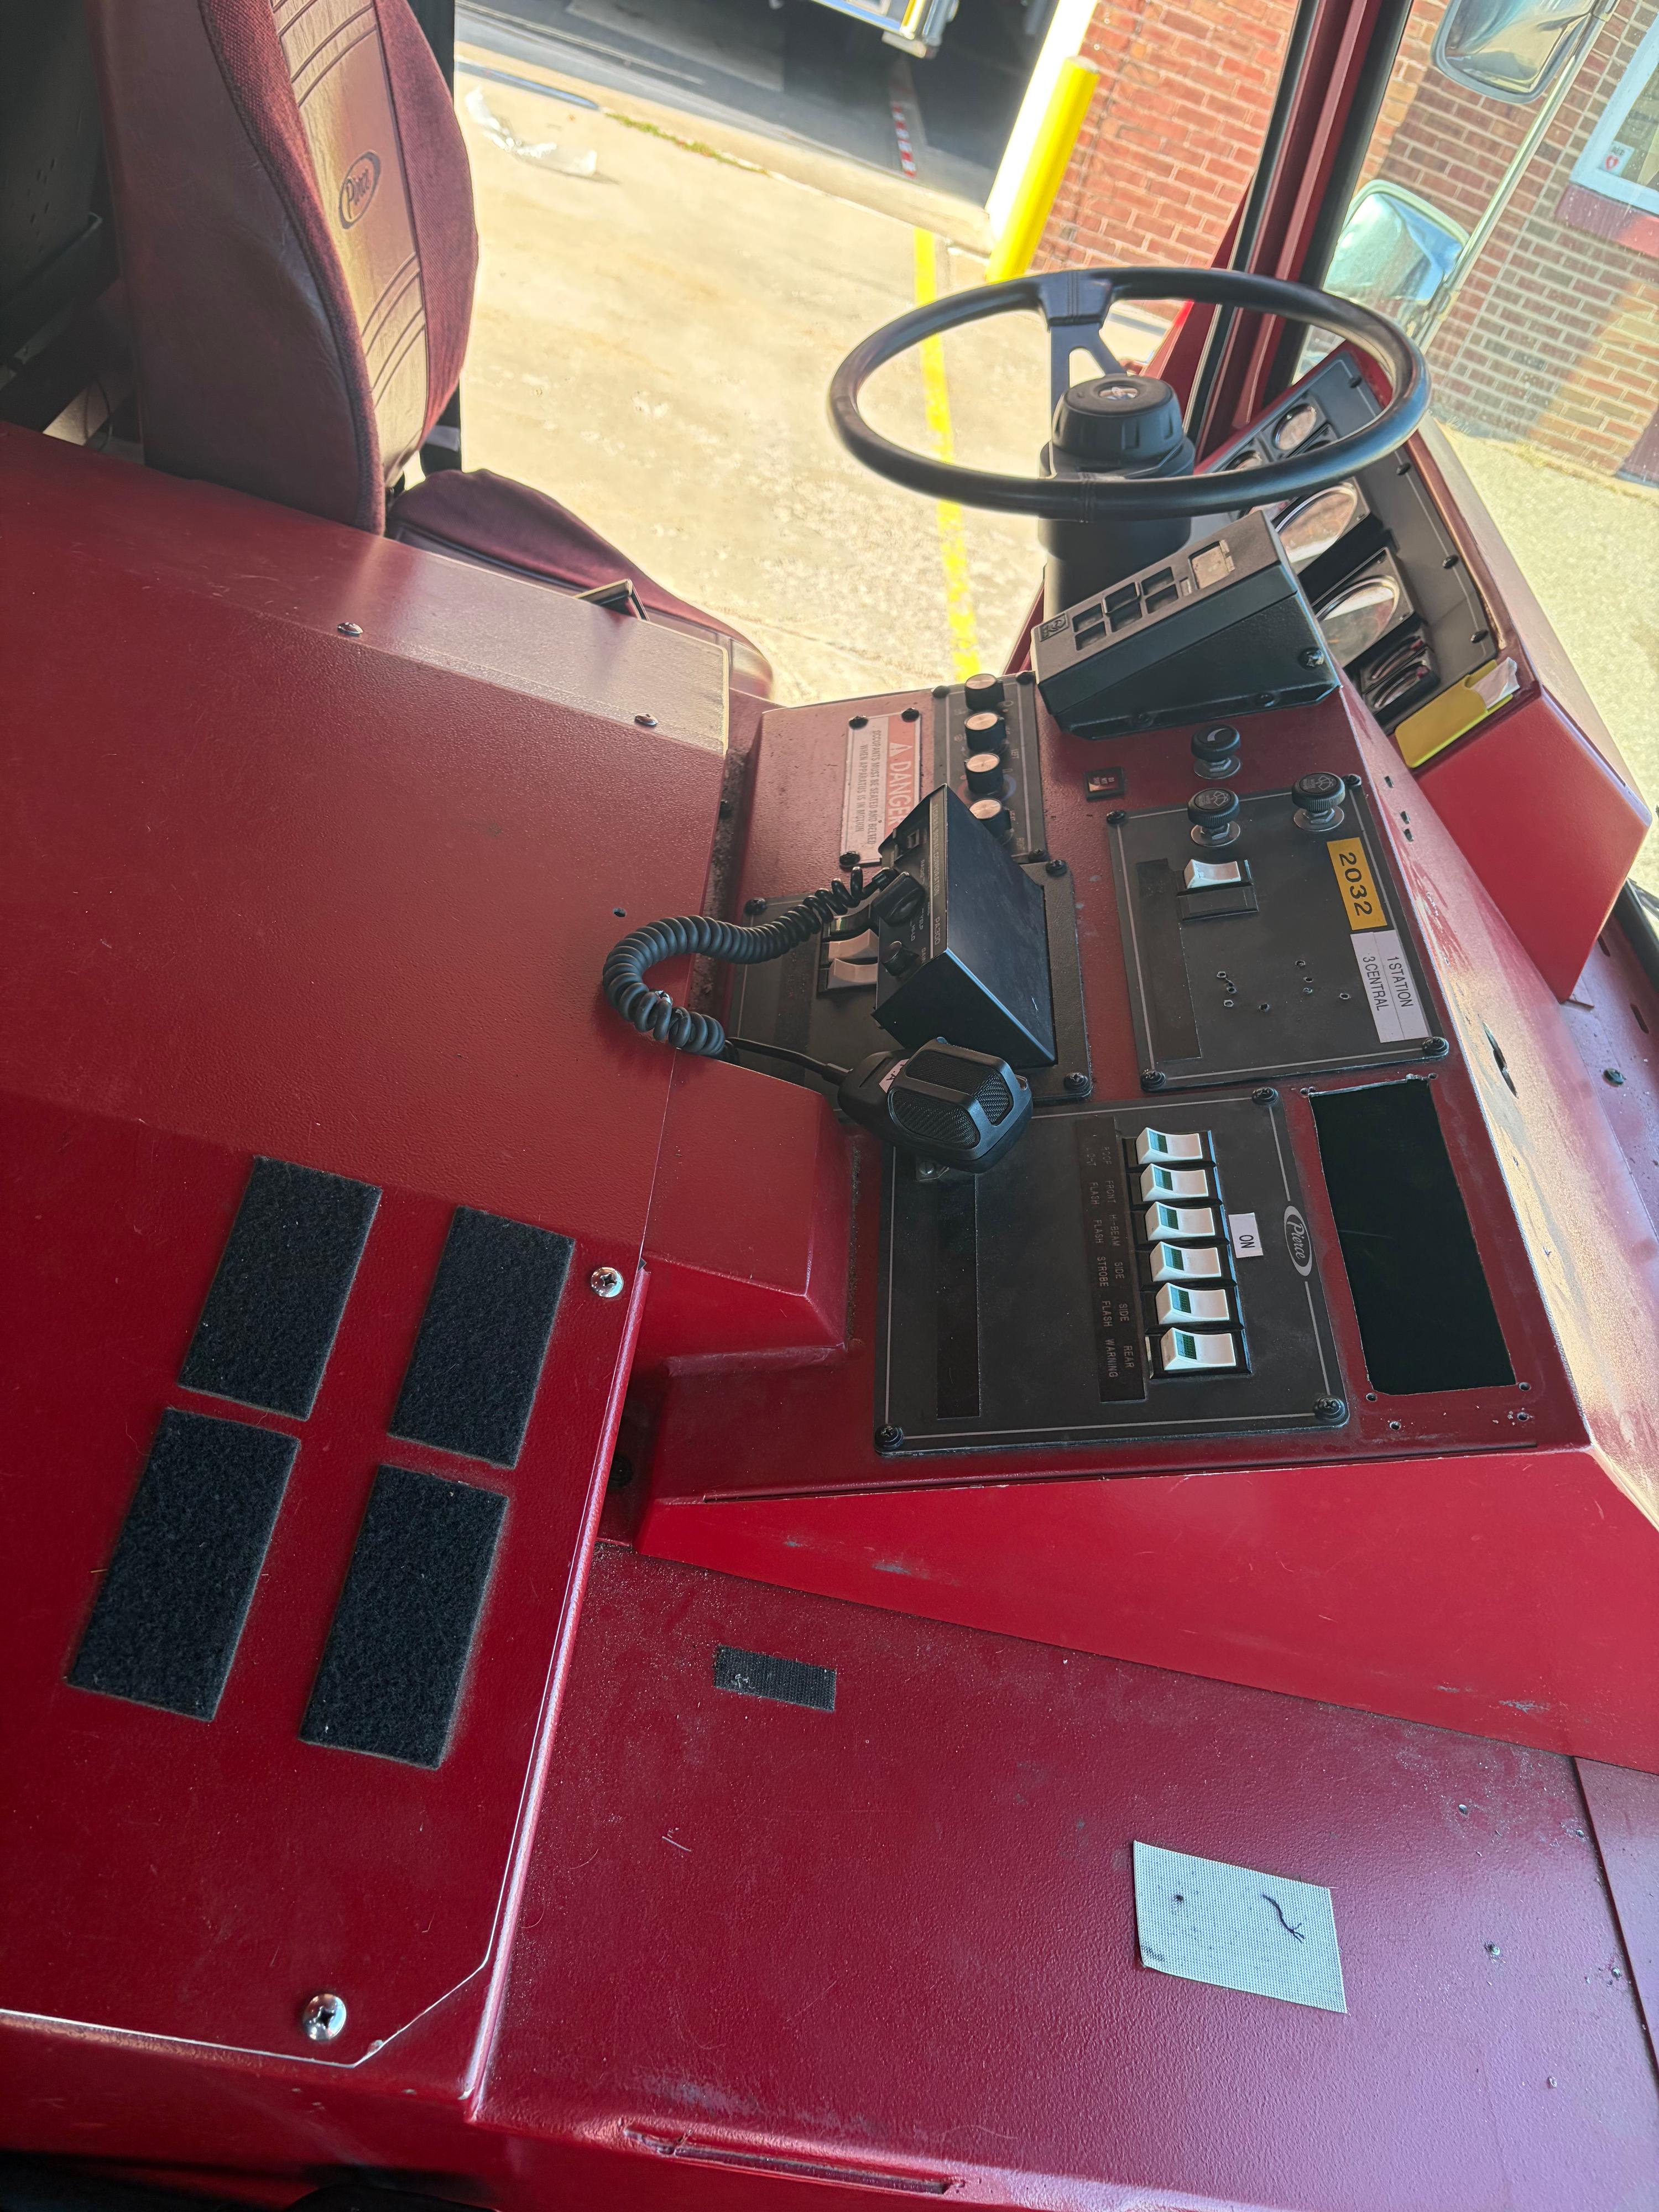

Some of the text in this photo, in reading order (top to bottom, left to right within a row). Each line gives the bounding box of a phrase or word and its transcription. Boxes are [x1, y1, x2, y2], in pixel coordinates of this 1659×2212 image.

[859, 744, 868, 761] WHEN
[871, 730, 881, 761] OCCUPANTS
[857, 762, 868, 793] APPARATUS
[870, 762, 880, 778] MUST
[869, 787, 878, 808] SEATED
[888, 761, 912, 826] DANGER
[854, 810, 864, 832] MOTION
[868, 810, 878, 822] AND
[867, 823, 877, 844] BELTED
[1339, 852, 1373, 916] 2032
[1089, 1182, 1100, 1205] FLASH
[1105, 1180, 1116, 1204] FRONT
[1093, 1219, 1104, 1244] FLASH
[1109, 1214, 1120, 1247] HI-BEAM
[1239, 1234, 1255, 1249] ON
[1286, 1221, 1306, 1259] Pierce
[1097, 1256, 1109, 1287] STROBE
[1114, 1261, 1125, 1279] SIDE
[1101, 1300, 1113, 1327] FLASH
[1119, 1303, 1130, 1322] SIDE
[1105, 1338, 1119, 1378] WARNING
[1123, 1345, 1135, 1369] REAR
